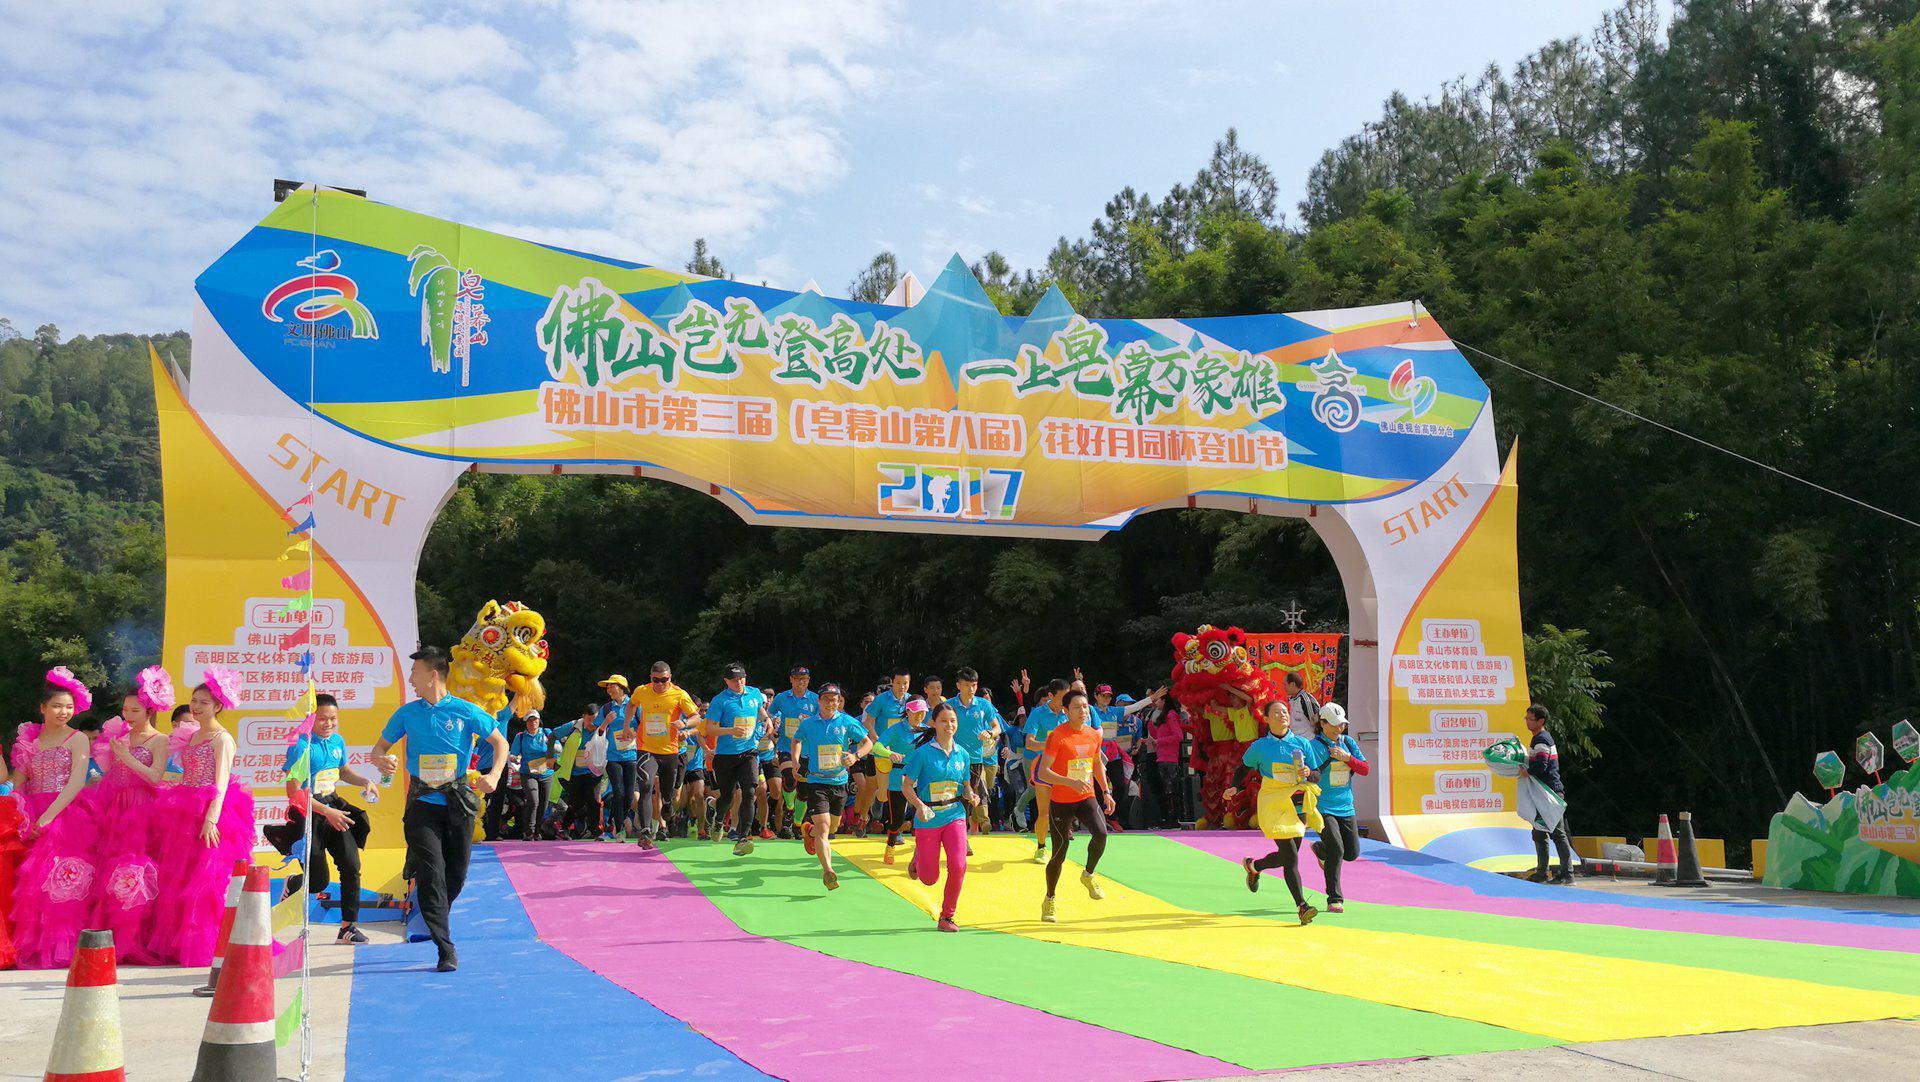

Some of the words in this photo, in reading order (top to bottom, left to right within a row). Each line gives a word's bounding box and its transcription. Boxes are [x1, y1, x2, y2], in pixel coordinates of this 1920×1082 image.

[283, 321, 353, 340] 文明佛山
[542, 280, 922, 388] 佛山岂无登高处
[966, 317, 1284, 426] 一上皂幕万象雄
[543, 386, 774, 438] 佛山市第三届
[794, 402, 1025, 455] (皂幕山第八届)
[1044, 421, 1286, 468] 花好月园杯登山节
[1380, 420, 1454, 438] 佛山电视台高明分台
[267, 431, 407, 527] START
[879, 462, 1025, 520] 2017
[1382, 471, 1469, 547] START
[248, 633, 336, 647] 佛山育局
[1433, 627, 1469, 640] 主办单位
[1426, 645, 1478, 657] 佛山市体育局
[1411, 673, 1498, 685] 高明区杨和镇人民政府
[1417, 687, 1496, 700] 高明区直机关党工委
[1440, 716, 1477, 729] 冠名单位
[1445, 777, 1481, 789] 承办单位
[1425, 799, 1502, 810] 佛山电视台高明分台
